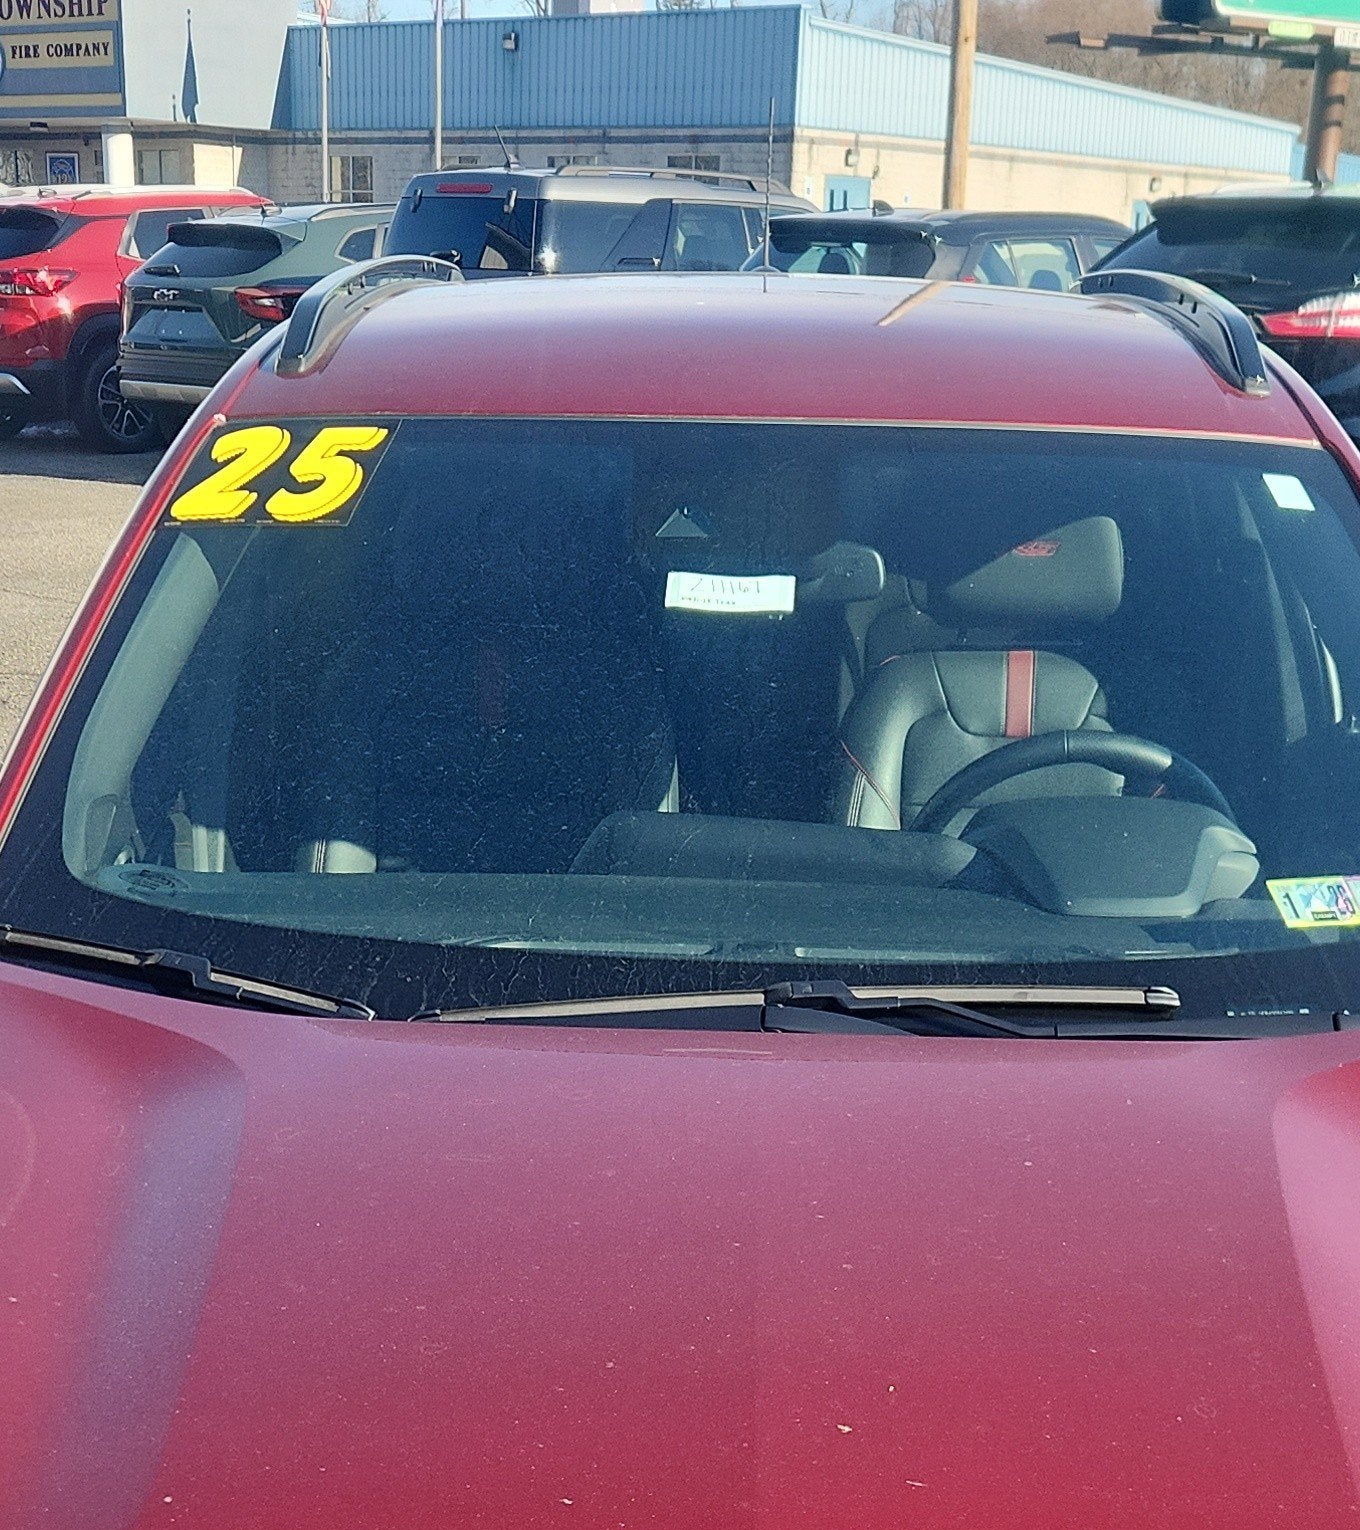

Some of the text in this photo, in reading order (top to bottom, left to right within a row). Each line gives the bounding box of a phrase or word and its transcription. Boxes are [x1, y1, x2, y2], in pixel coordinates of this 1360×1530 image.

[10, 43, 40, 59] FIRE
[46, 41, 110, 58] COMPANY
[170, 425, 389, 523] 25
